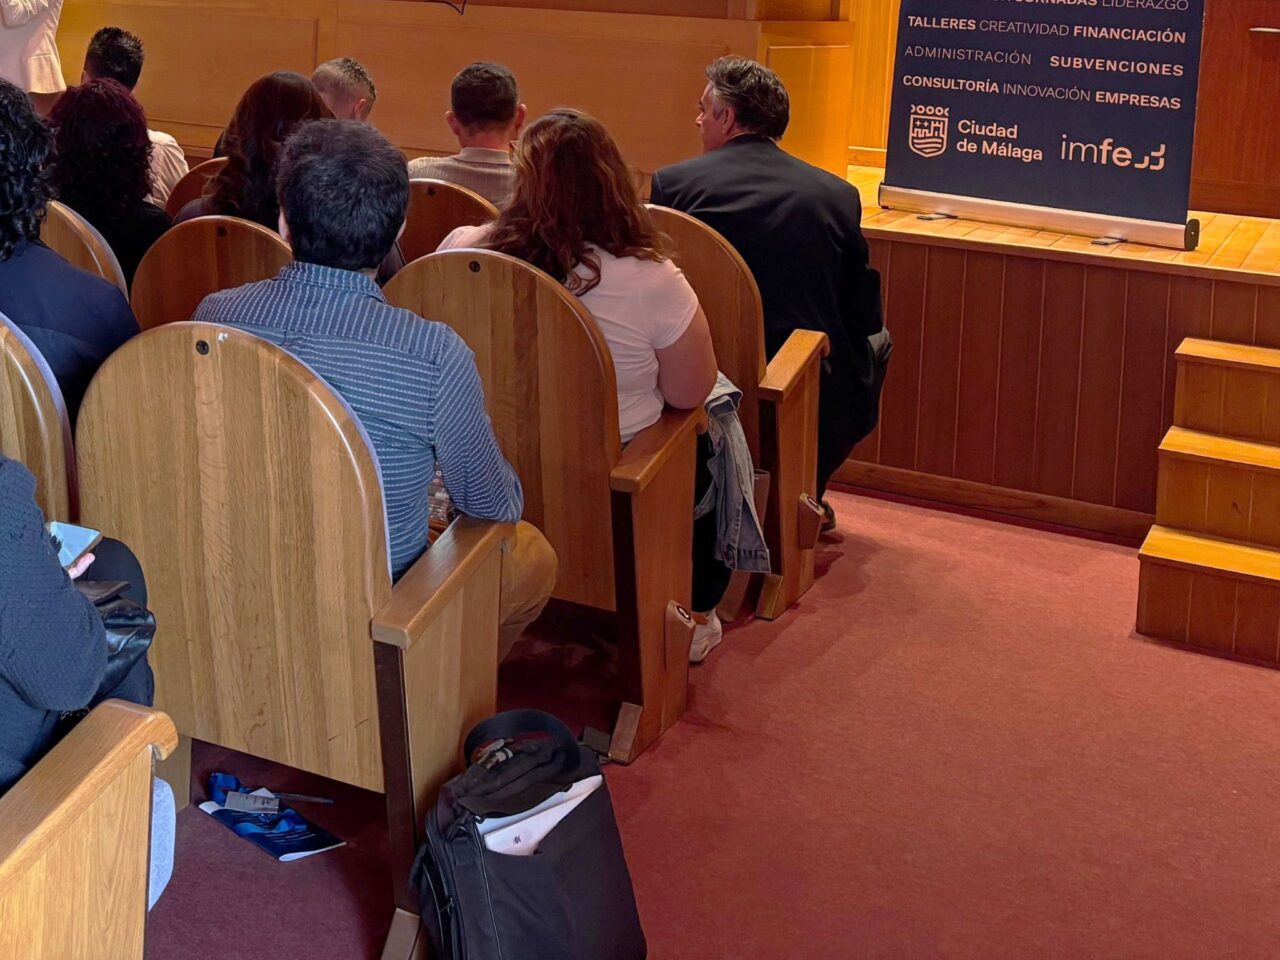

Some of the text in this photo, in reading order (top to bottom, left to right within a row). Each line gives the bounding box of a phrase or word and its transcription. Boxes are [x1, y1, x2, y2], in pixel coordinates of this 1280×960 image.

[908, 16, 1186, 43] TALLERES CREATIVIDAD FINANCIACIÓN
[905, 46, 1183, 76] ADMINISTRACIÓN SUBVENCIONES
[903, 74, 1181, 109] CONSULTORÍA INNOVACIÓN EMPRESAS
[958, 119, 1017, 139] Ciudad
[957, 139, 1042, 162] de Málaga
[1061, 134, 1132, 167] imfe
